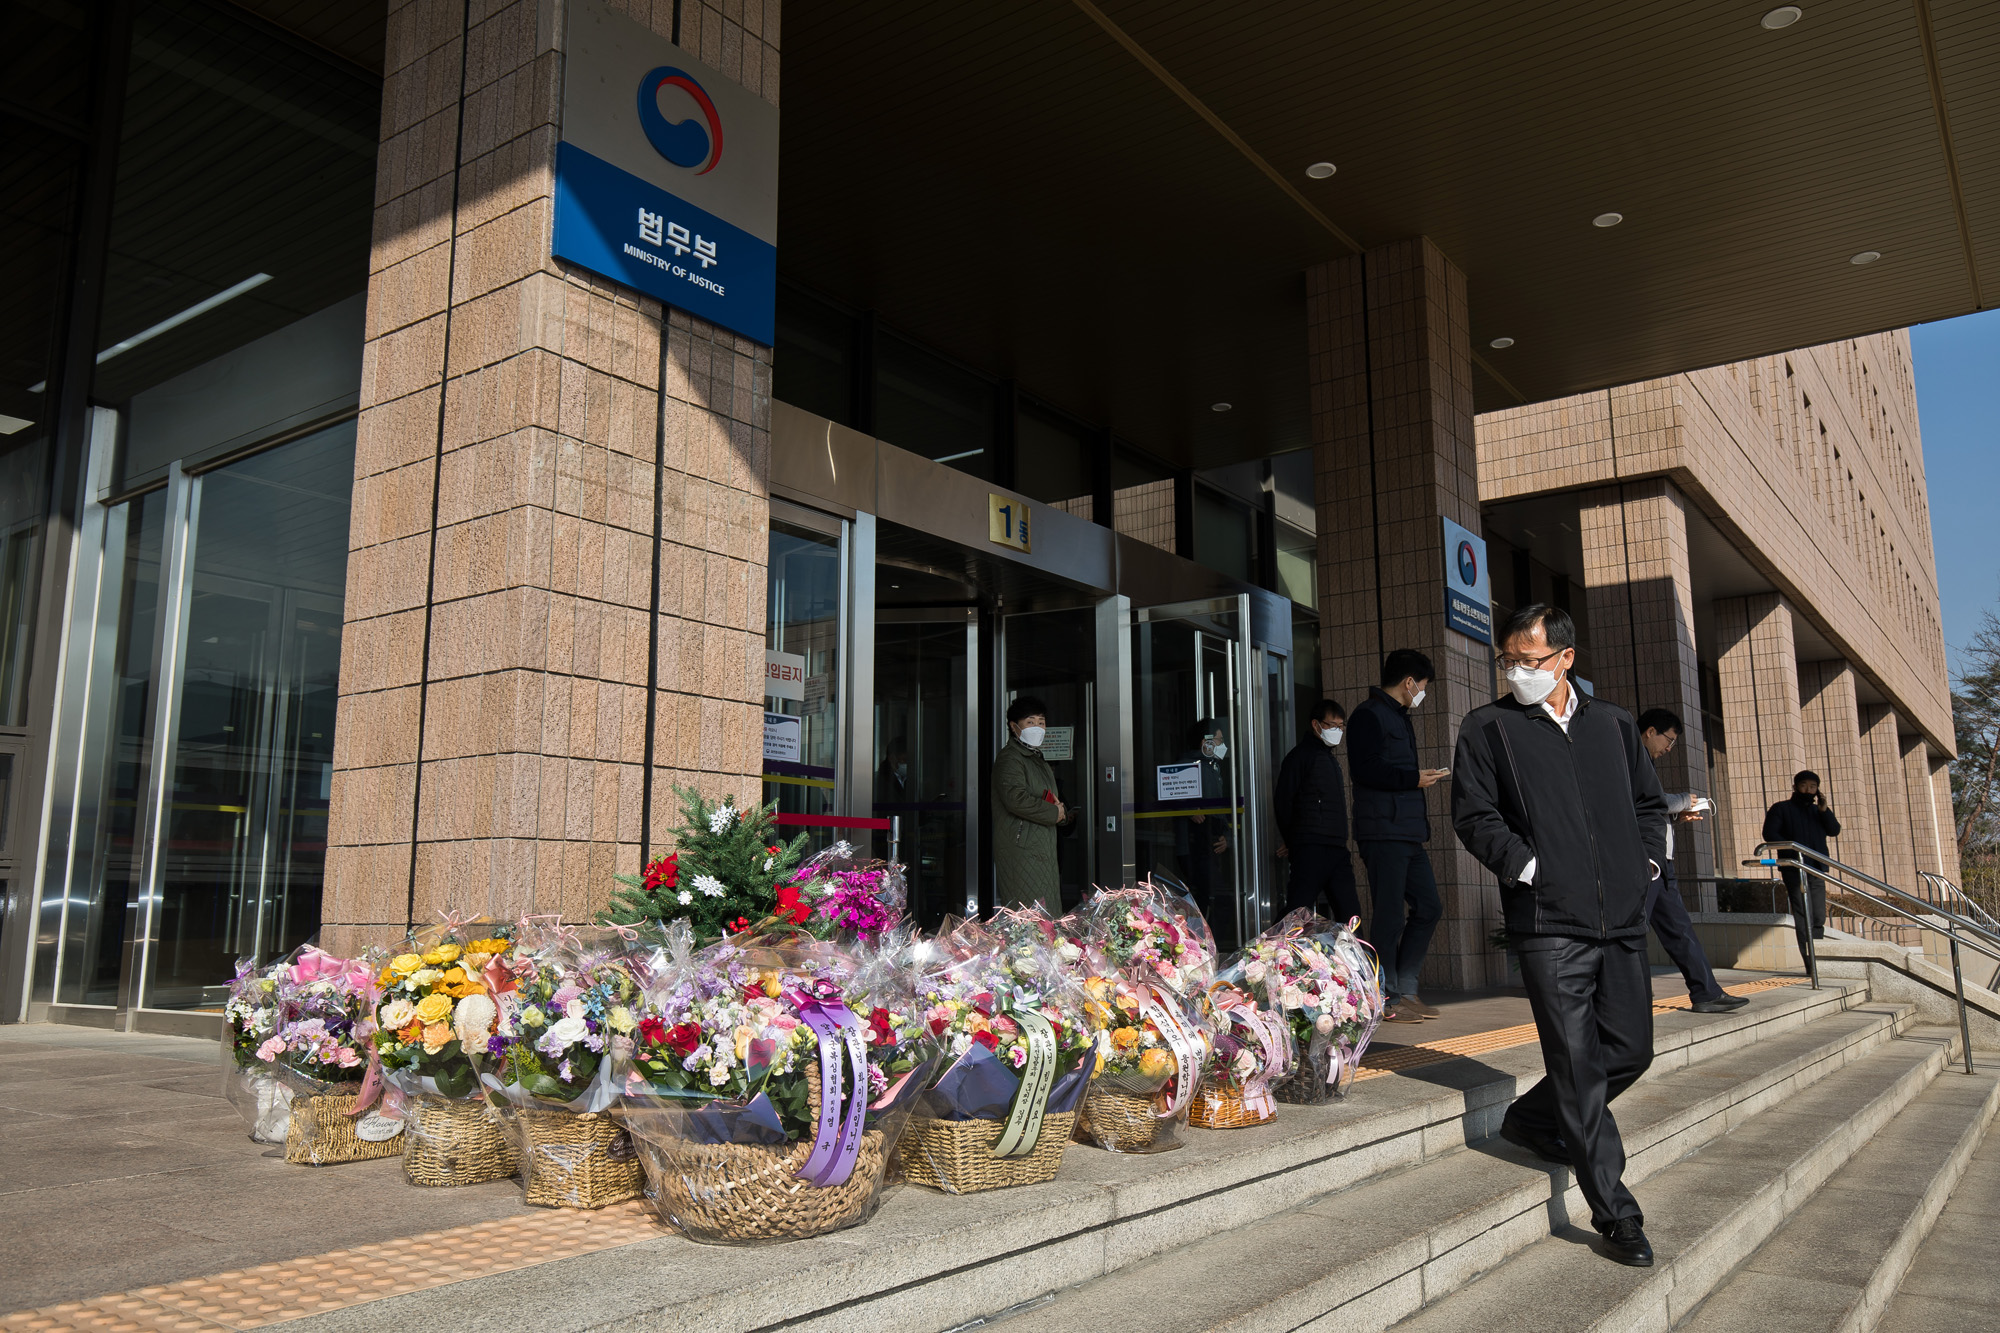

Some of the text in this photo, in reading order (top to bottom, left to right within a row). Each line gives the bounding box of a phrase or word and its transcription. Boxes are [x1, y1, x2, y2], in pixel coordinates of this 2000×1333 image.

[639, 208, 717, 268] 법무부
[624, 243, 725, 296] MINISTRY OF JUSTICE
[847, 1025, 863, 1064] 장관님
